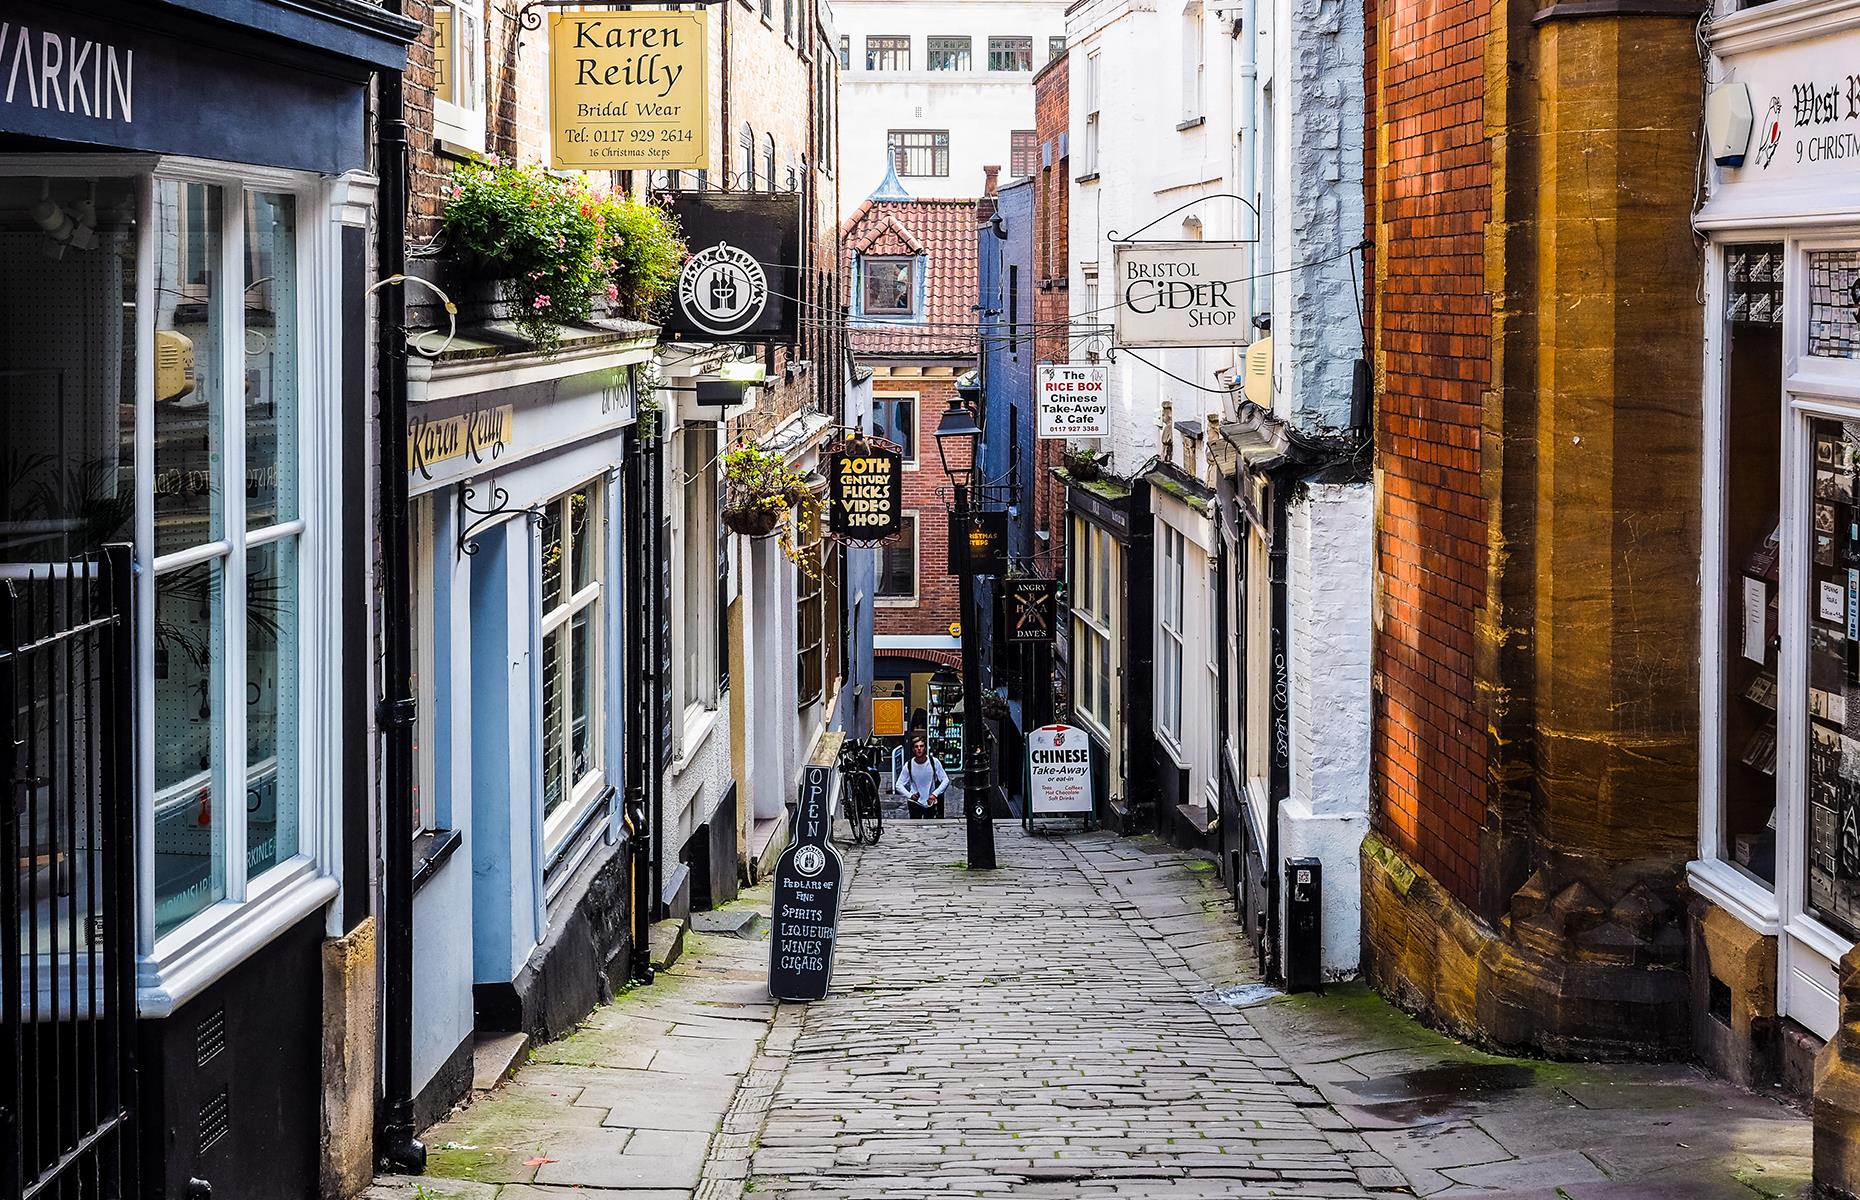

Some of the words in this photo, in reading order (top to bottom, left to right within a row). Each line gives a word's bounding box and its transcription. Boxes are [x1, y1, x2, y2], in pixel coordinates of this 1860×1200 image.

[573, 21, 685, 48] Karen
[574, 53, 683, 98] Reilly
[577, 101, 629, 117] Bridal
[635, 102, 681, 116] Wear
[1792, 82, 1840, 128] West
[565, 127, 589, 143] Tel:
[593, 129, 625, 142] 0117
[630, 129, 655, 142] 929
[660, 129, 693, 142] 2614
[589, 148, 599, 157] 16
[601, 146, 645, 158] Christmas
[648, 147, 670, 160] Steps
[1796, 140, 1803, 163] 9
[715, 240, 730, 262] &
[1127, 261, 1200, 280] BRISTOL
[1188, 308, 1236, 328] SHOP
[1063, 371, 1085, 380] The
[1045, 382, 1074, 391] RICE
[1078, 382, 1102, 391] BOX
[1050, 394, 1098, 403] Chinese
[1042, 404, 1106, 415] Take-Away
[1055, 414, 1063, 424] &
[1068, 414, 1094, 424] Cafe
[408, 412, 459, 481] Karen
[463, 407, 505, 464] Reilly
[840, 458, 891, 474] 20TH
[840, 475, 891, 485] CENTURY
[842, 485, 891, 499] FLICKS
[841, 499, 891, 513] VIDEO
[848, 513, 891, 527] SHOP
[1017, 584, 1047, 592] ANGRY
[1017, 629, 1047, 637] DAVE'S
[1031, 750, 1088, 764] CHINESE
[1032, 766, 1088, 776] Take-Away
[807, 768, 823, 838] OPEN
[783, 877, 822, 890] PEDLARS
[823, 881, 834, 889] OF
[796, 891, 815, 902] FINE
[782, 904, 823, 921] SPIRITS
[781, 922, 834, 939] LIQUEURS
[781, 939, 822, 955] WINES
[781, 955, 823, 975] CIGARS
